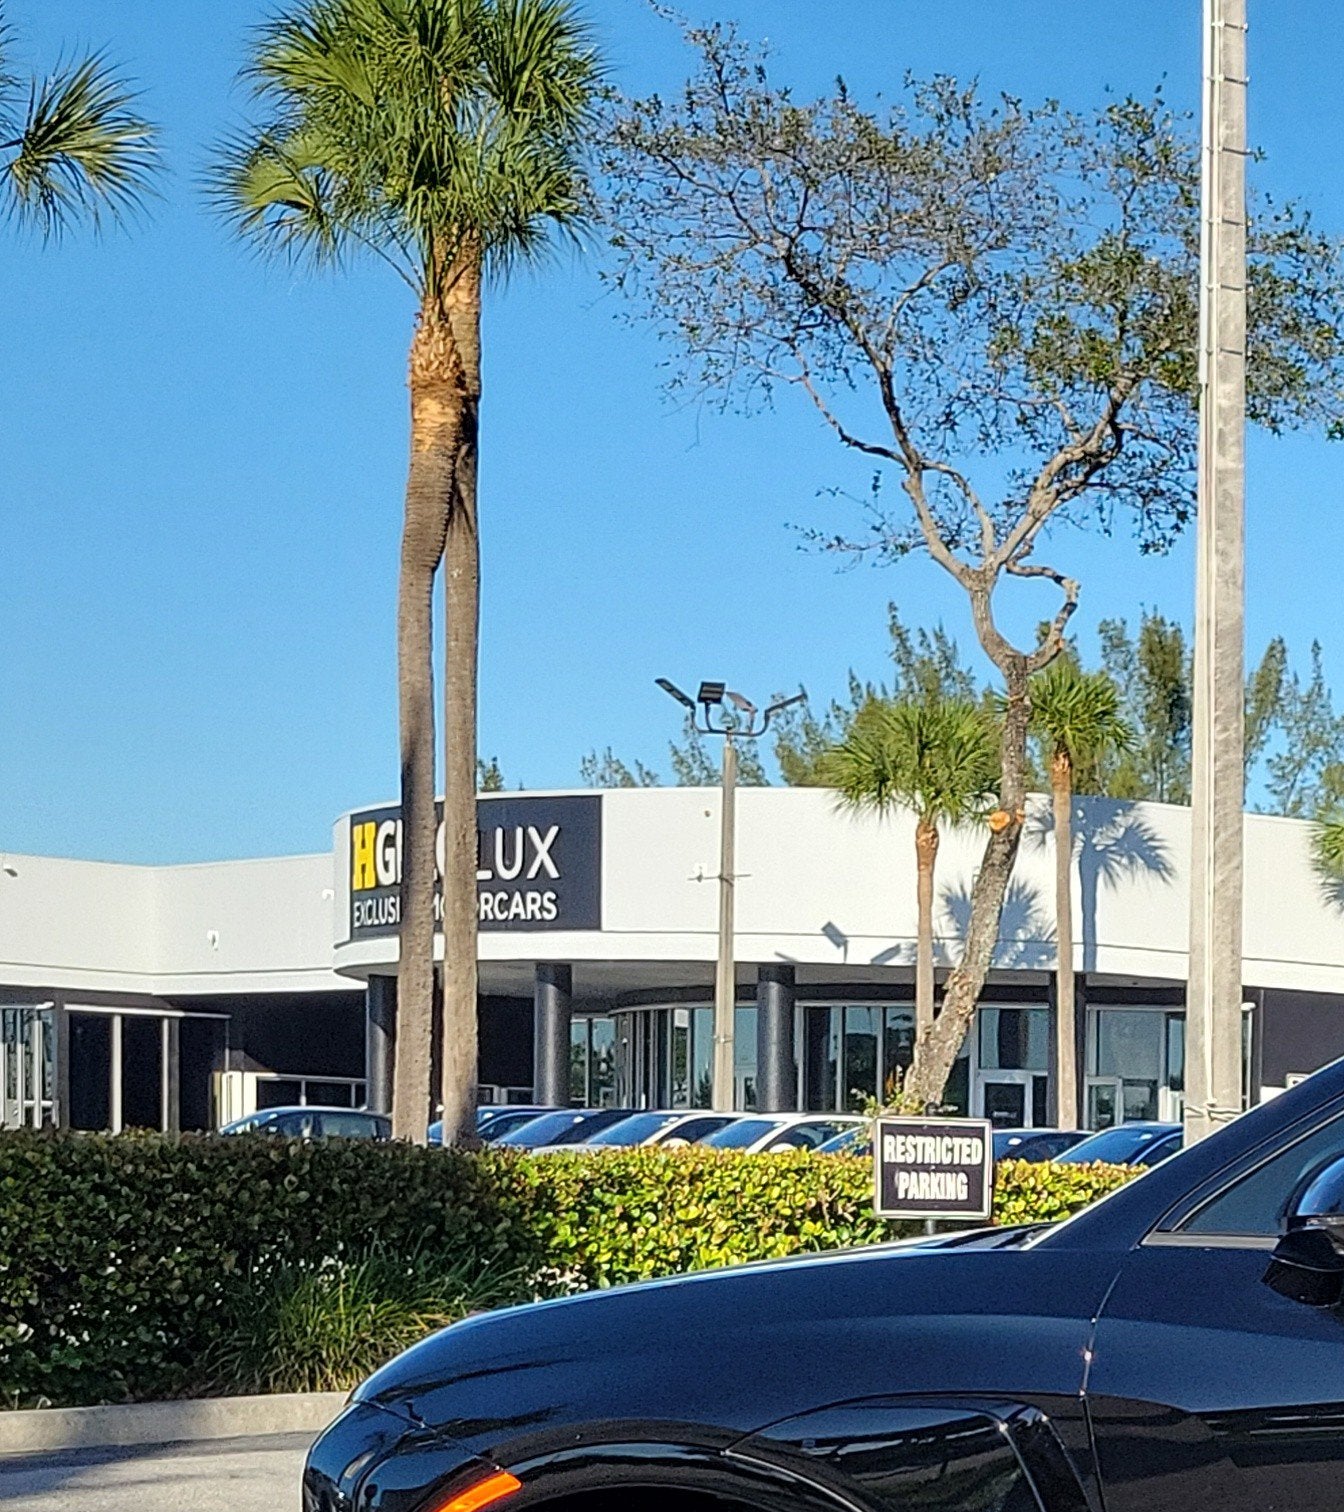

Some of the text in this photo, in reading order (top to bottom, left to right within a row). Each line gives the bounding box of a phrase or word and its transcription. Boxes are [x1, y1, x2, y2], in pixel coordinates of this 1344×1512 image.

[353, 895, 401, 928] EXCLUSI
[883, 1134, 983, 1166] RESTRICTED
[897, 1171, 969, 1201] PARKING
